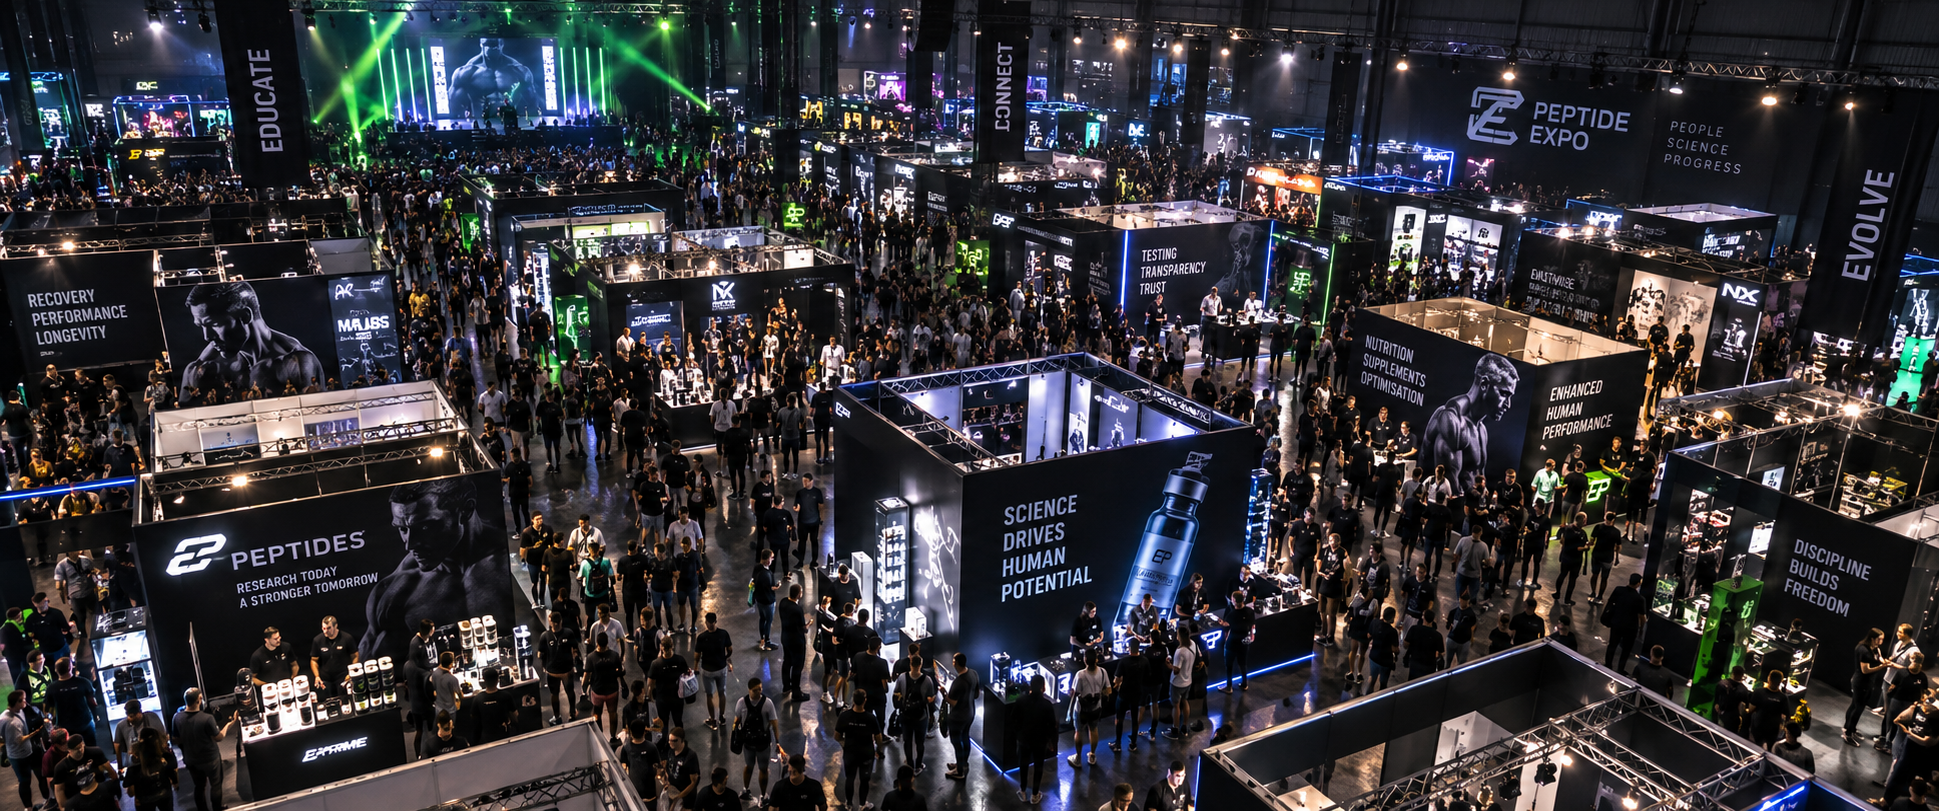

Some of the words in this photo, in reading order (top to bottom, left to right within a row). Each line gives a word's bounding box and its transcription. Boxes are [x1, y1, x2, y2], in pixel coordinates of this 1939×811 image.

[247, 49, 283, 152] EDUCATE
[1534, 102, 1630, 132] PEPTIDE
[1670, 121, 1723, 137] PEOPLE
[1530, 125, 1588, 150] EXPO
[1667, 138, 1728, 155] SCIENCE
[1664, 154, 1741, 174] PROGRESS
[1842, 170, 1894, 281] EVOLVE
[1142, 248, 1177, 261] TESTING
[1141, 262, 1206, 278] TRANSPARENCY
[28, 289, 94, 307] RECOVERY
[1140, 281, 1166, 295] TRUST
[32, 305, 127, 326] PERFORMANCE
[36, 325, 105, 345] LONGEVITY
[1366, 335, 1413, 363] NUTRITION
[1363, 353, 1426, 387] SUPPLEMENTS
[1361, 371, 1423, 406] OPTIMISATION
[1550, 380, 1602, 401] ENHANCED
[1546, 402, 1583, 420] HUMAN
[1543, 414, 1612, 440] PERFORMANCE
[1004, 495, 1077, 525] SCIENCE
[1004, 522, 1064, 551] DRIVES
[231, 531, 364, 570] PEPTIDES
[1003, 547, 1065, 577] HUMAN
[1152, 549, 1172, 566] EP
[1794, 539, 1871, 580] DISCIPLINE
[237, 574, 297, 593] RESEARCH
[300, 566, 336, 581] TODAY
[1002, 566, 1092, 602] POTENTIAL
[1789, 559, 1839, 590] BUILDS
[240, 598, 247, 608] A
[251, 586, 311, 606] STRONGER
[317, 573, 377, 593] TOMORROW
[1784, 578, 1849, 617] FREEDOM
